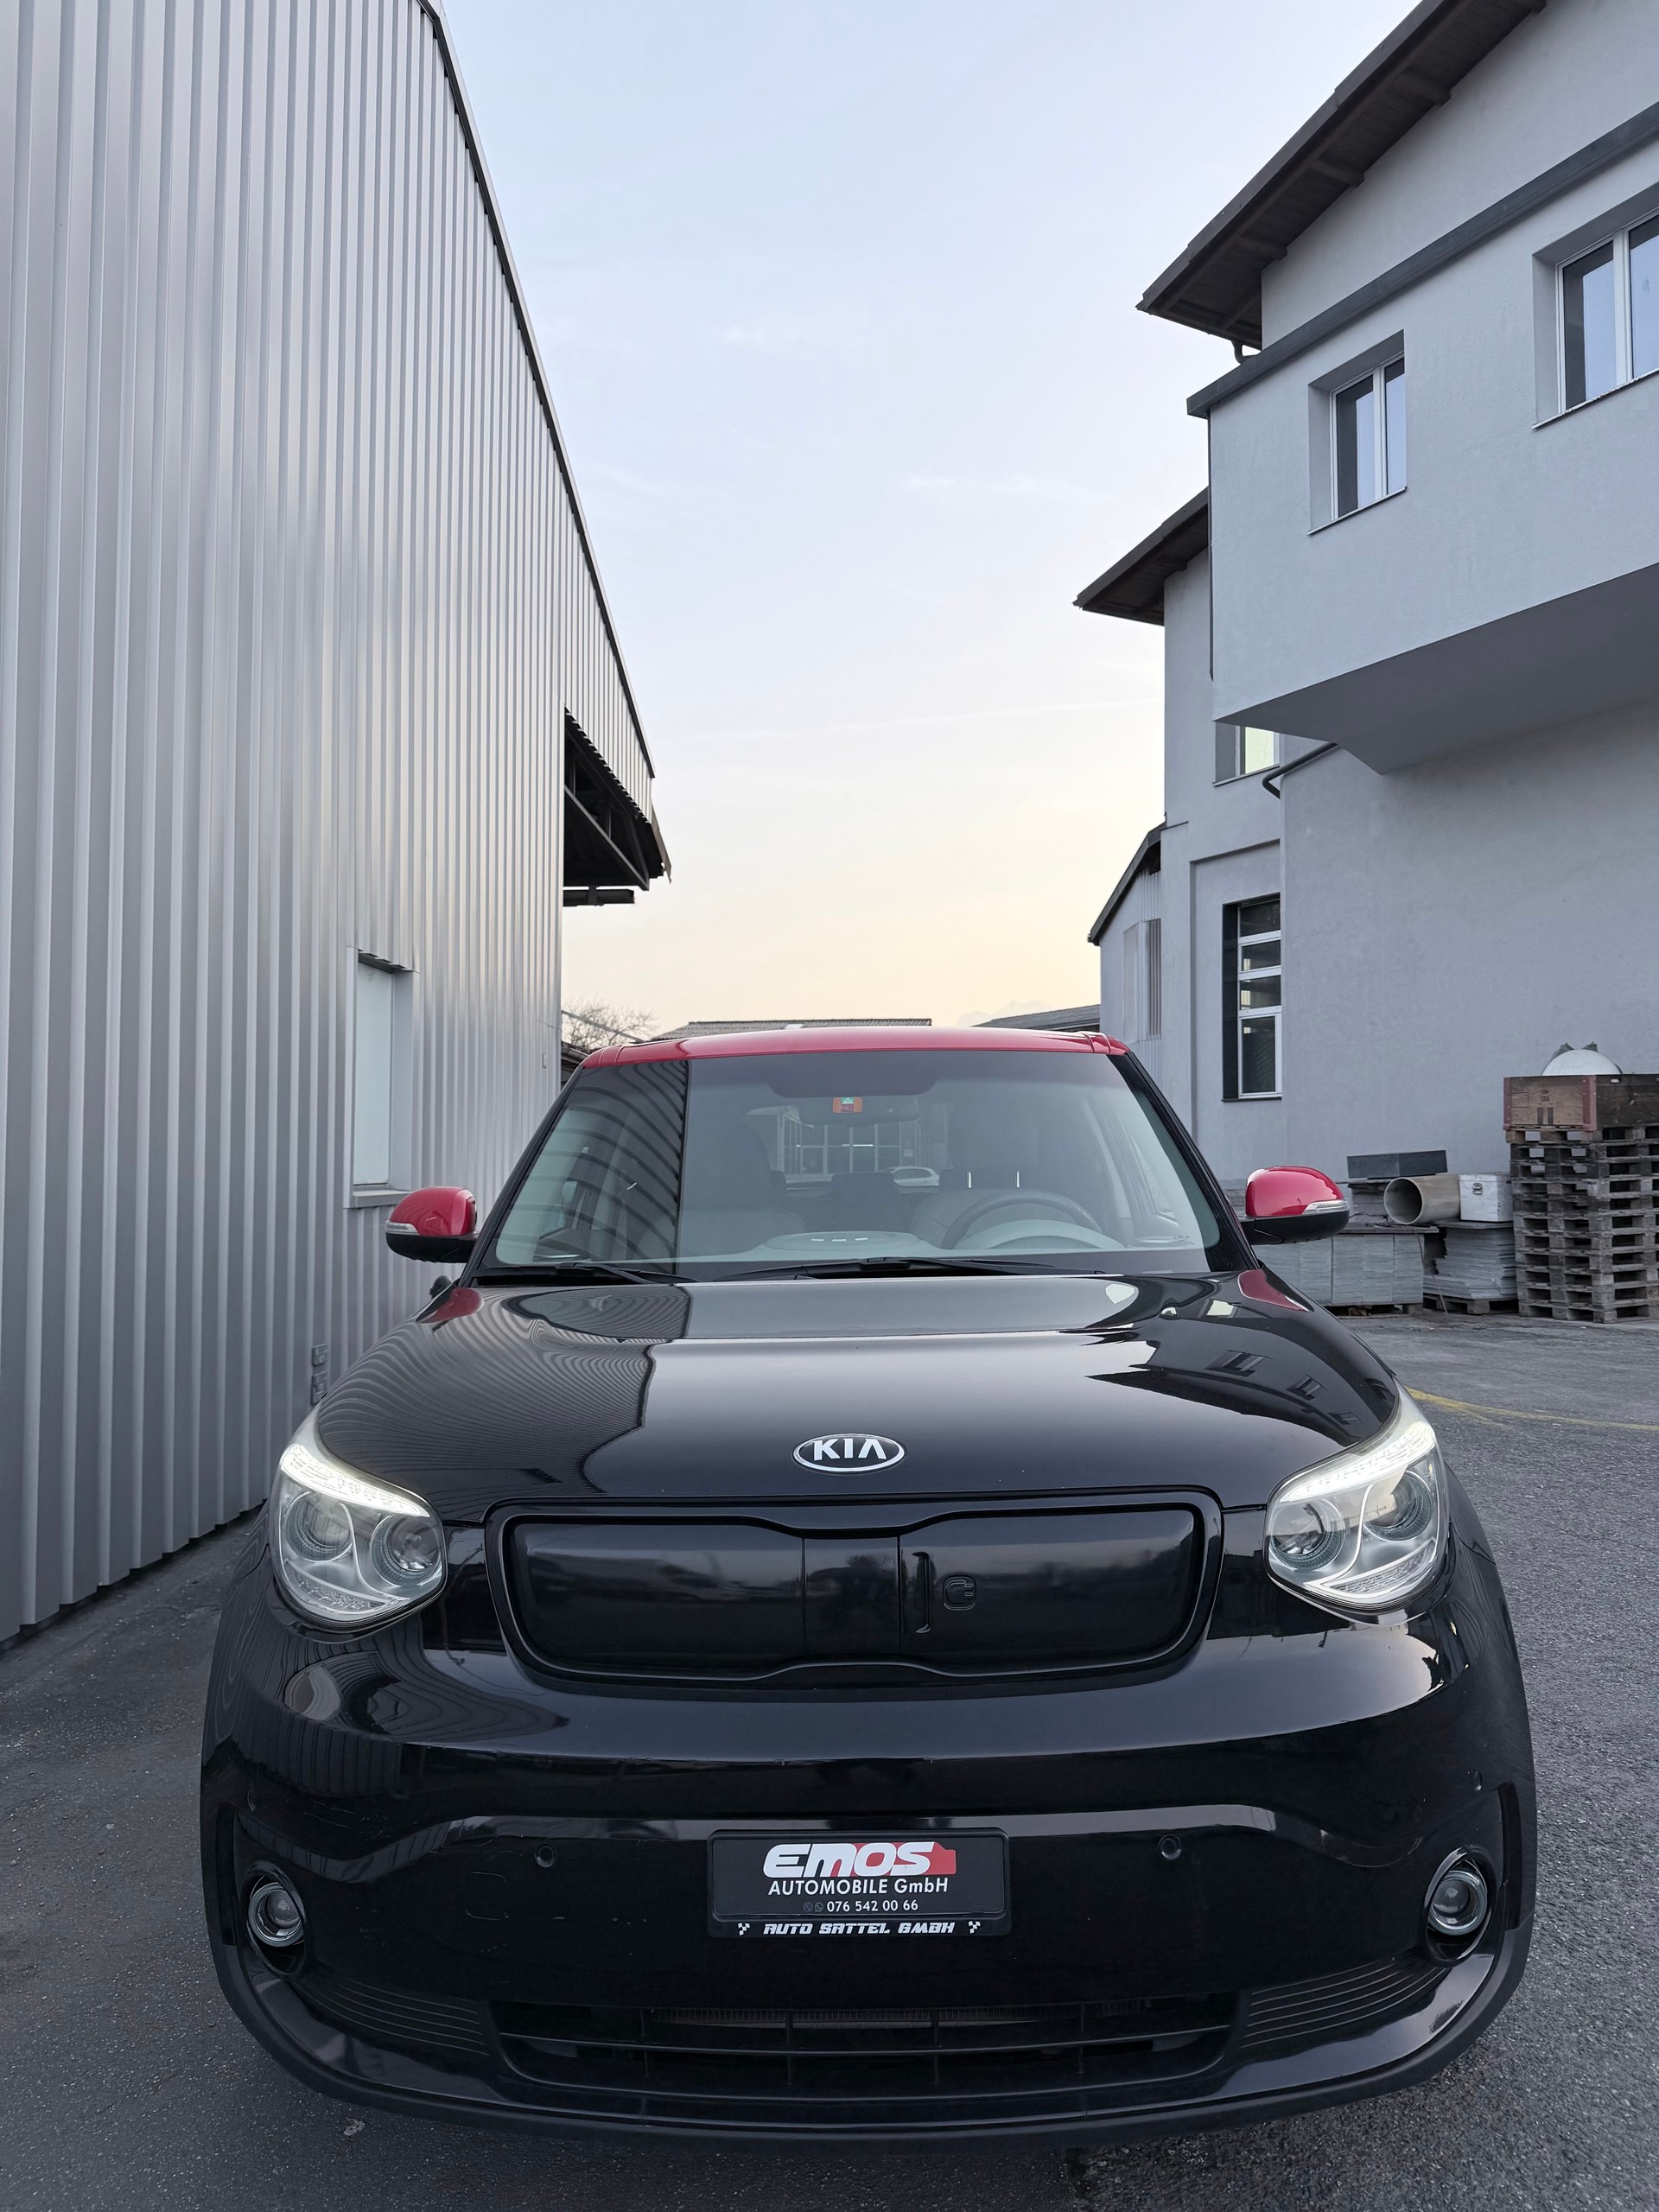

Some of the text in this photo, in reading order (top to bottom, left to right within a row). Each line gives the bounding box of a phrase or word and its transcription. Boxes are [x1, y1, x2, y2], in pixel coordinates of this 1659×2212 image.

[813, 1438, 887, 1461] KIA
[763, 1841, 935, 1878] EMOS
[768, 1878, 949, 1896] AUTOMOBILE GmbH
[827, 1900, 918, 1912] 076 542 00 66
[763, 1923, 956, 1935] AUTO SATTEL GMBH
